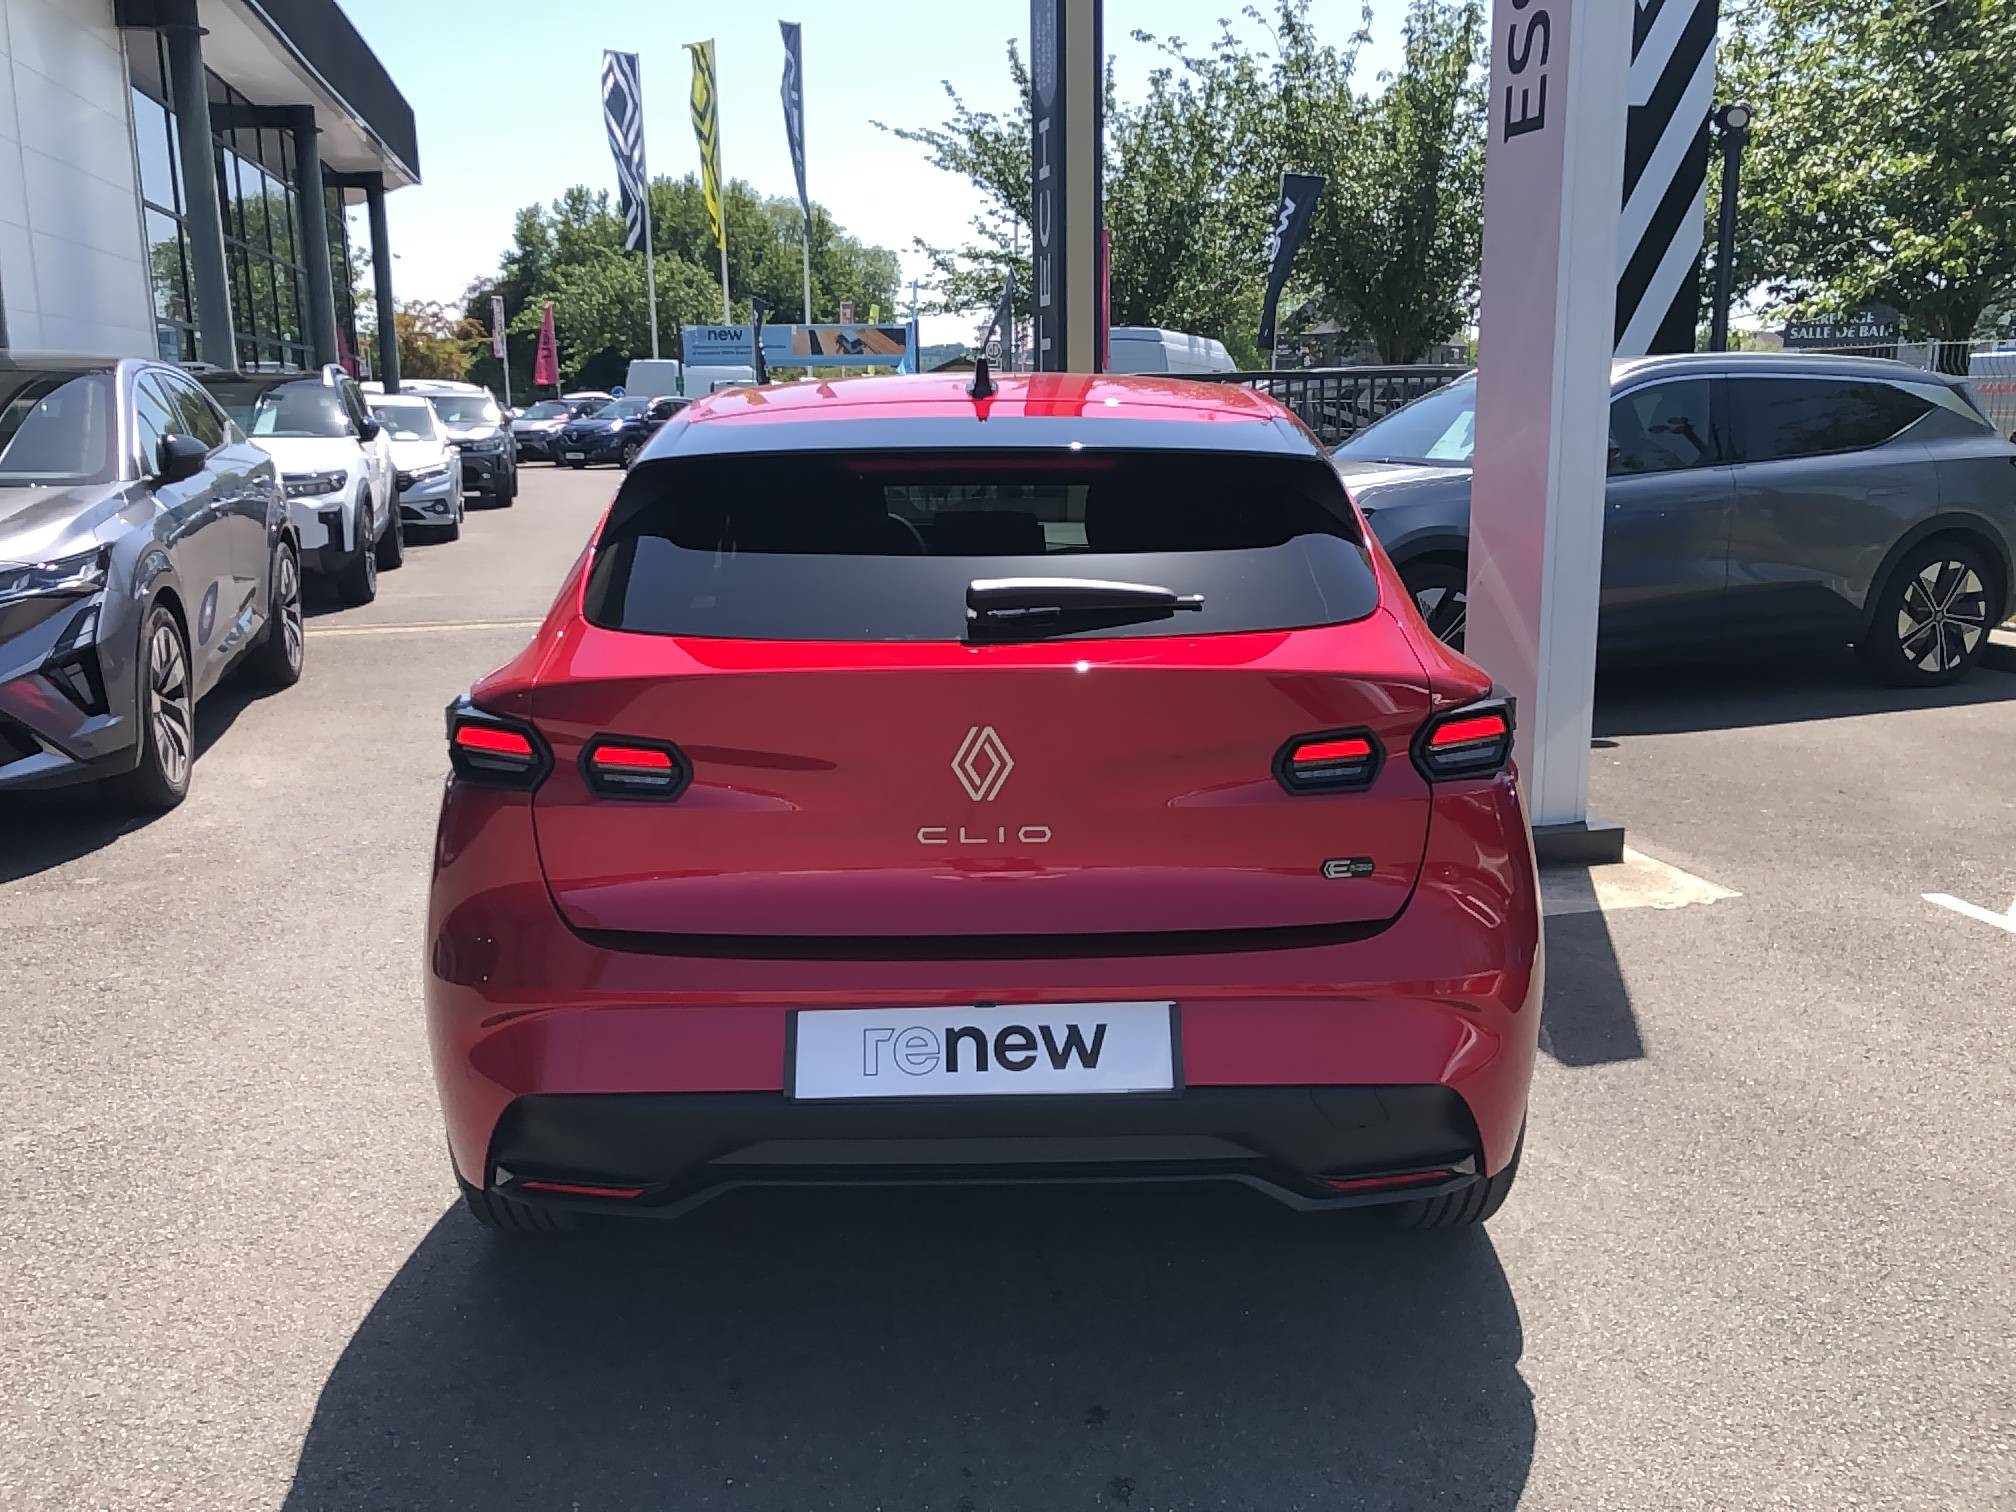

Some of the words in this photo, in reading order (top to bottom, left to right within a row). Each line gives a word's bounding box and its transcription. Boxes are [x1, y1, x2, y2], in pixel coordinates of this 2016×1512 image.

[1504, 0, 1551, 144] ES
[1038, 117, 1051, 373] TECH
[1790, 326, 1832, 339] SALLE
[916, 826, 1053, 845] CLIO
[863, 1023, 1108, 1077] renew
